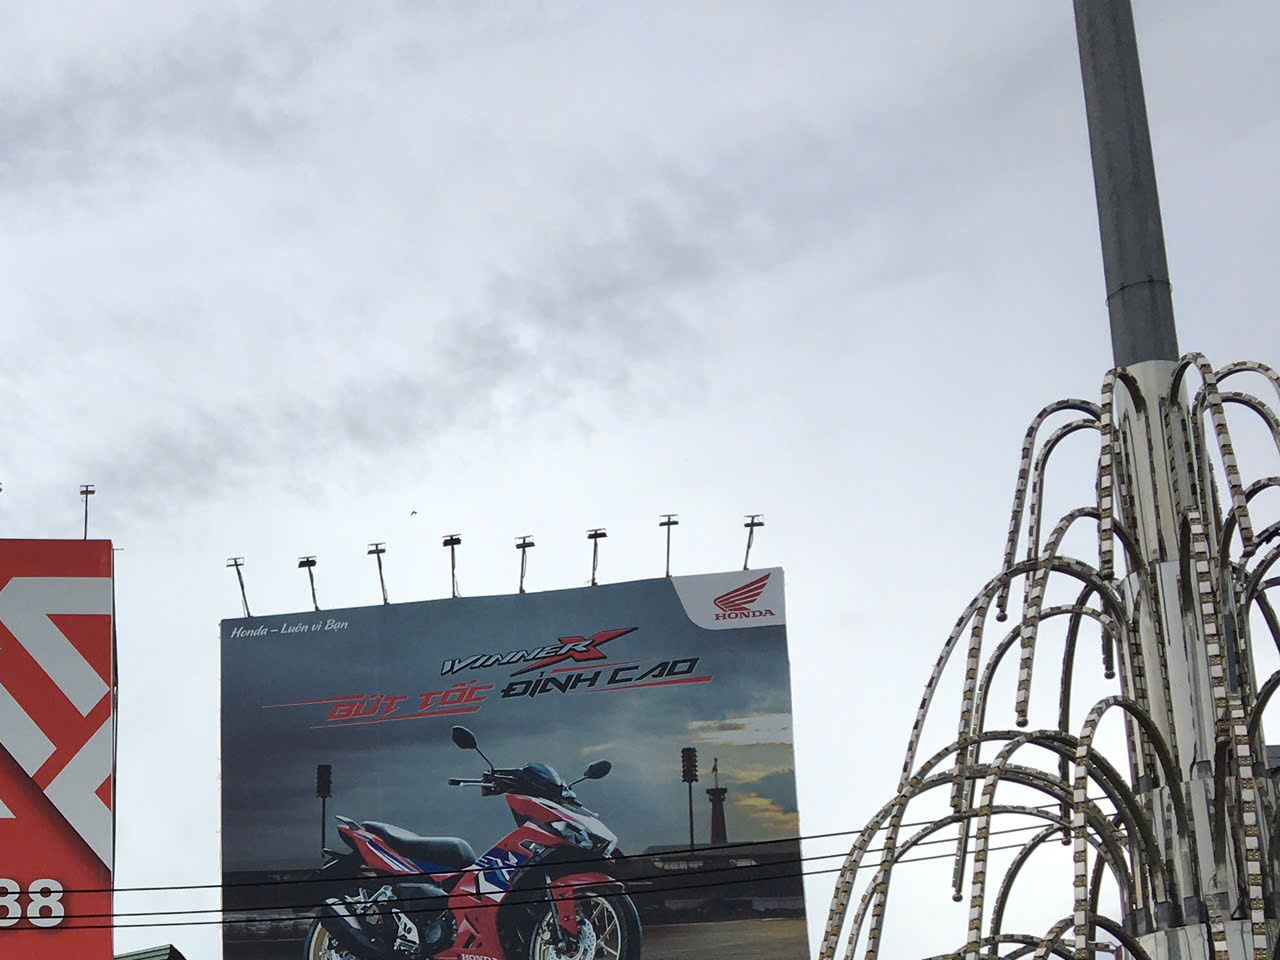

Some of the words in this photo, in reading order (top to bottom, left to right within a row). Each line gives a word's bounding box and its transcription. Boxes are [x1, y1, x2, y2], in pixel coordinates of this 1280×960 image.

[230, 624, 269, 638] Honda
[280, 622, 309, 634] Luôn
[311, 620, 323, 631] vì
[324, 619, 349, 632] Bạn
[714, 609, 775, 621] HONDA
[440, 639, 593, 676] WINNER
[418, 680, 495, 713] TỐC
[500, 671, 602, 699] ĐỈNH
[607, 657, 700, 685] CAO
